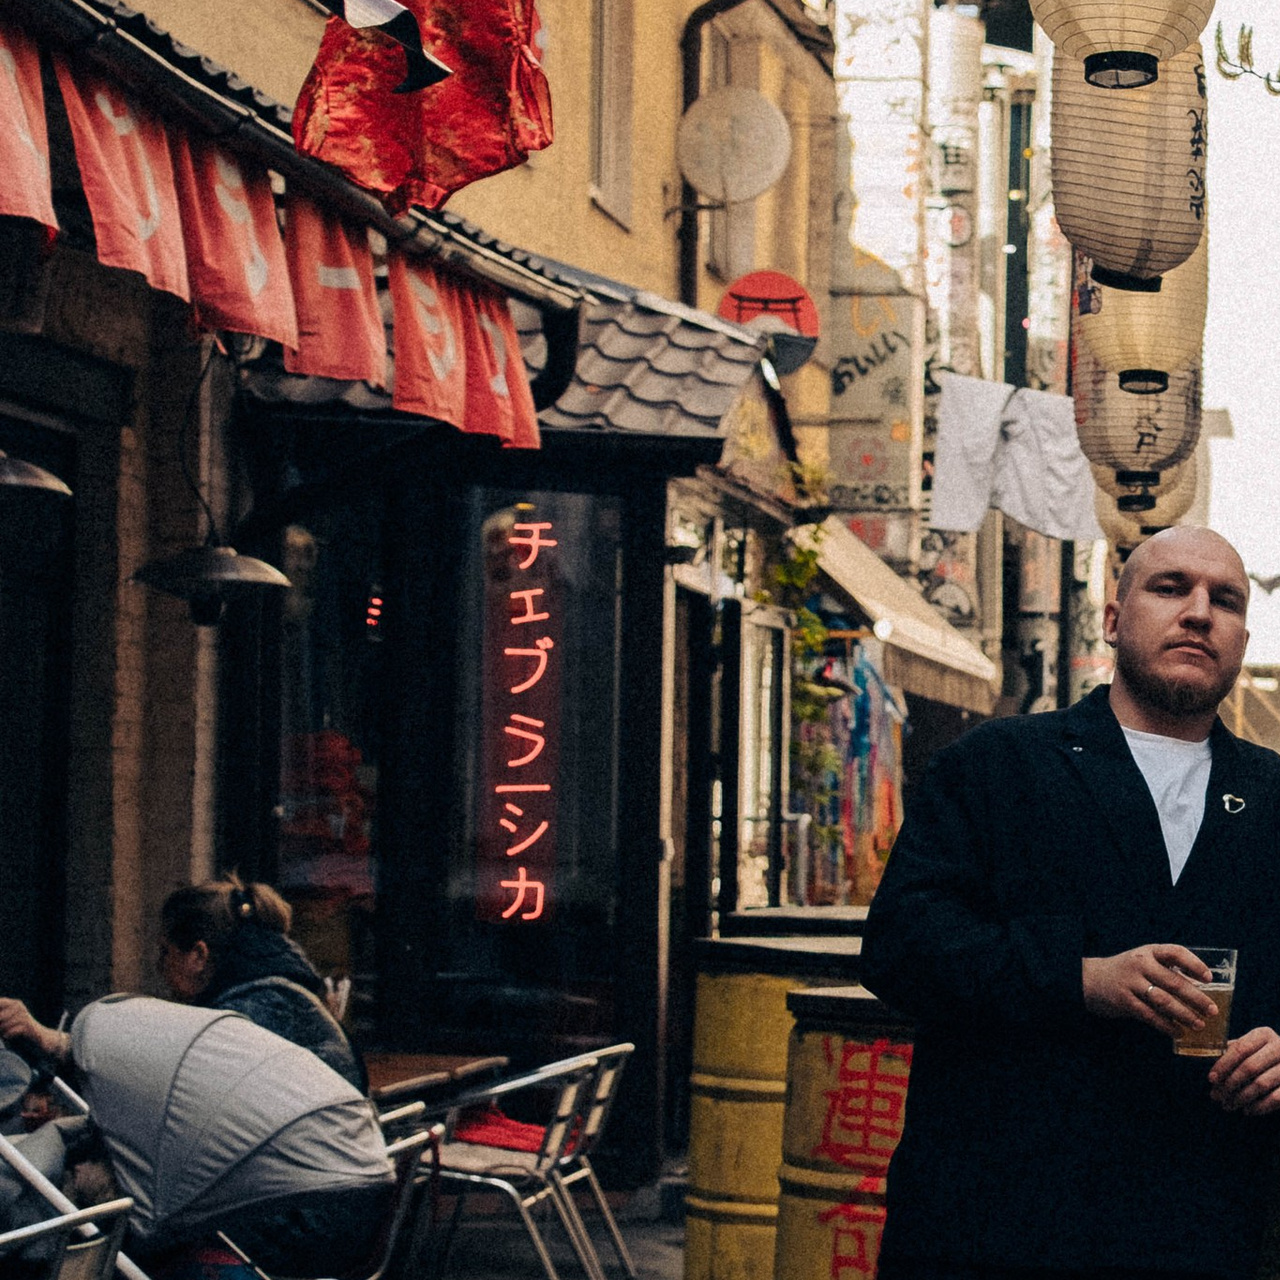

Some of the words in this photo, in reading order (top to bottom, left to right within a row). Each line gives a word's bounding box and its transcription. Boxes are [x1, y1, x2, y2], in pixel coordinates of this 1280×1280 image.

[495, 521, 558, 920] チェブラーシカ
